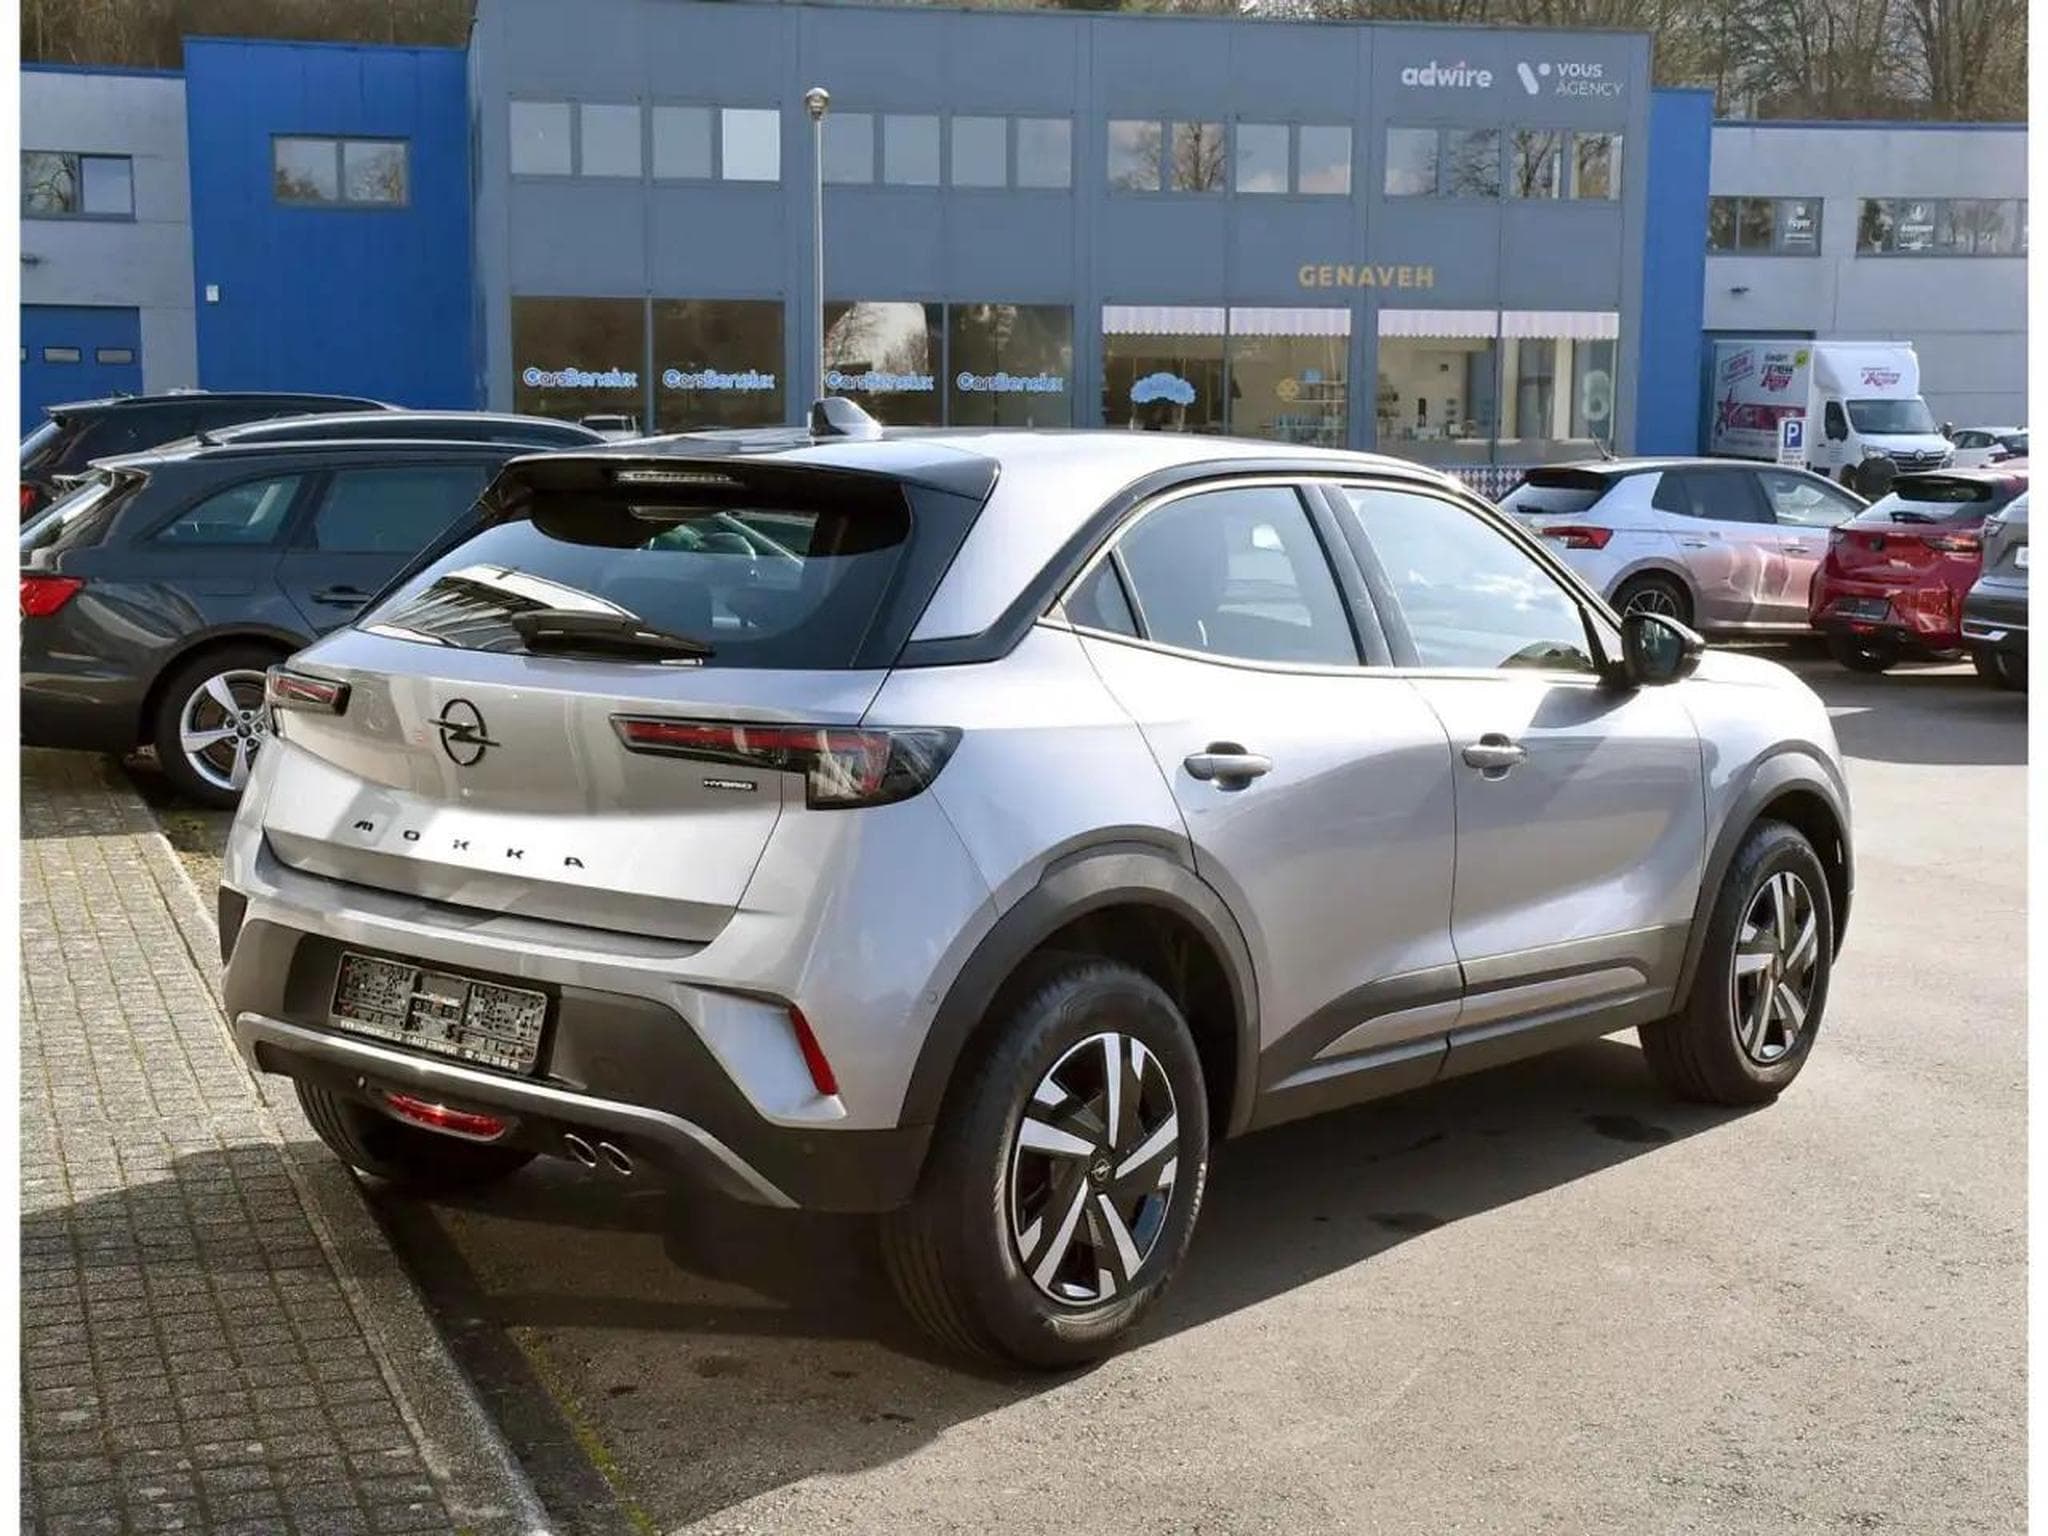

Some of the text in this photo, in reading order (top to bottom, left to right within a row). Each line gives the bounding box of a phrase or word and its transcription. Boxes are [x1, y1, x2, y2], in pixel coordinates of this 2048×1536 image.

[1401, 60, 1493, 88] adwire
[1557, 63, 1604, 78] VOUS
[1555, 80, 1625, 97] AGENCY
[1298, 265, 1435, 287] GENAVEH
[523, 367, 638, 388] CarsBenelux
[662, 368, 776, 390] CarsBenelux
[825, 370, 935, 391] CarsBenelux
[956, 371, 1064, 392] CarsBenelux
[1787, 423, 1799, 446] P
[703, 780, 753, 790] HYBRID
[353, 818, 586, 869] MOKKA
